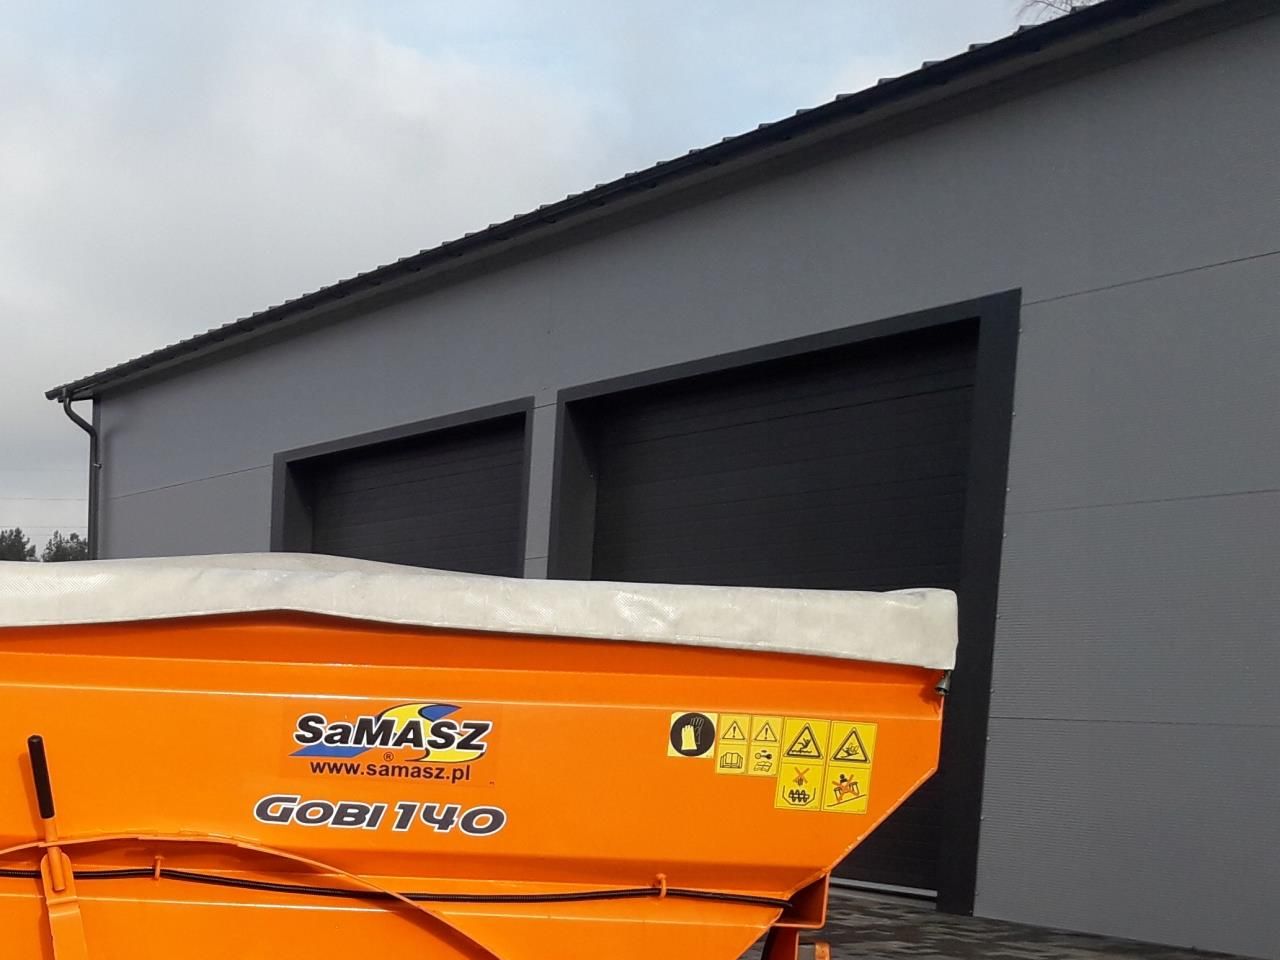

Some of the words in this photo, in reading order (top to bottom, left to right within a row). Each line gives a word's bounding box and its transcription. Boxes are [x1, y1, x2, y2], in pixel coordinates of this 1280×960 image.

[294, 713, 493, 752] SaMASZ
[310, 760, 470, 784] www.samasz.pl
[253, 794, 388, 831] GOBI
[392, 802, 507, 836] 140
